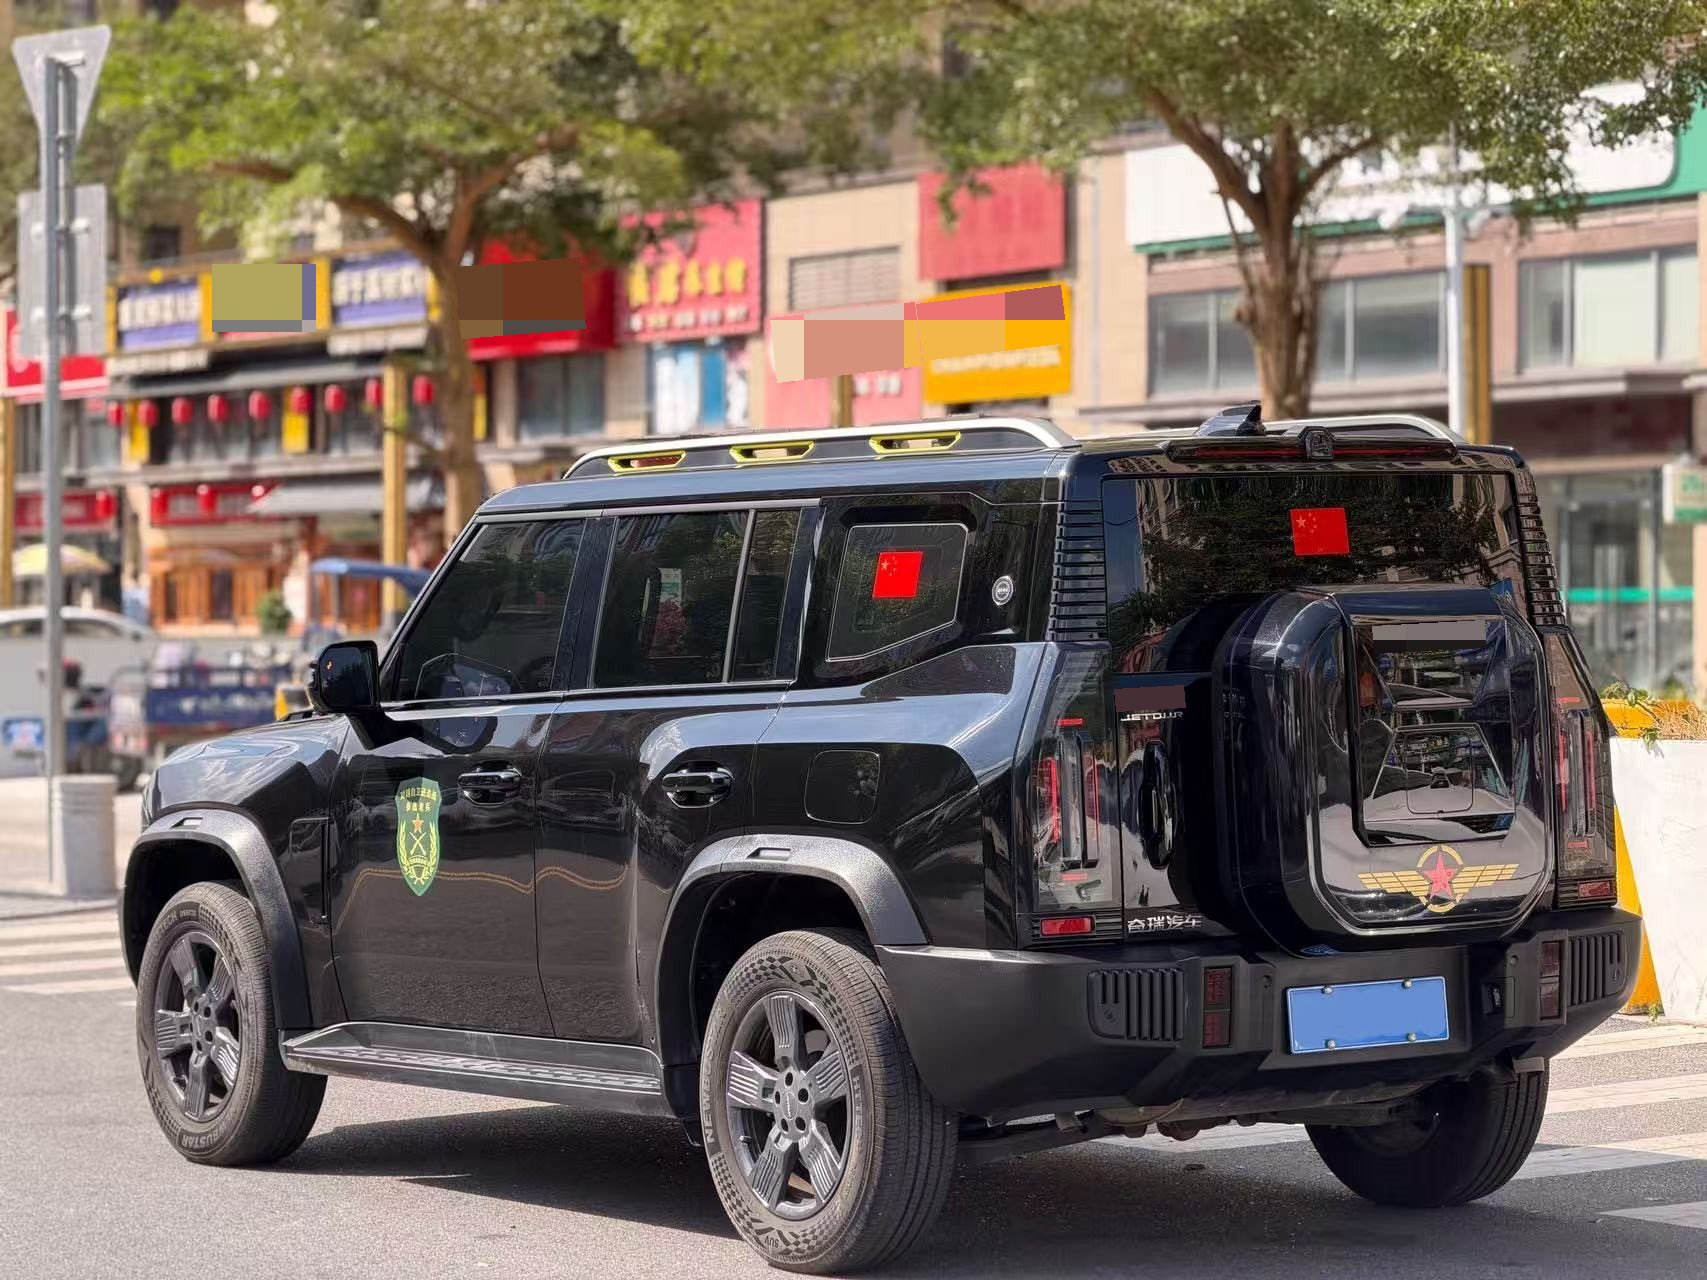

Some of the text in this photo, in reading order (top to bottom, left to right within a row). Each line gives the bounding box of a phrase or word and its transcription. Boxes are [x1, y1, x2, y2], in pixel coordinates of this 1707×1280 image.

[1120, 711, 1183, 721] JETOUR
[1127, 914, 1202, 933] 奇瑞汽车
[764, 1235, 780, 1248] SUV
